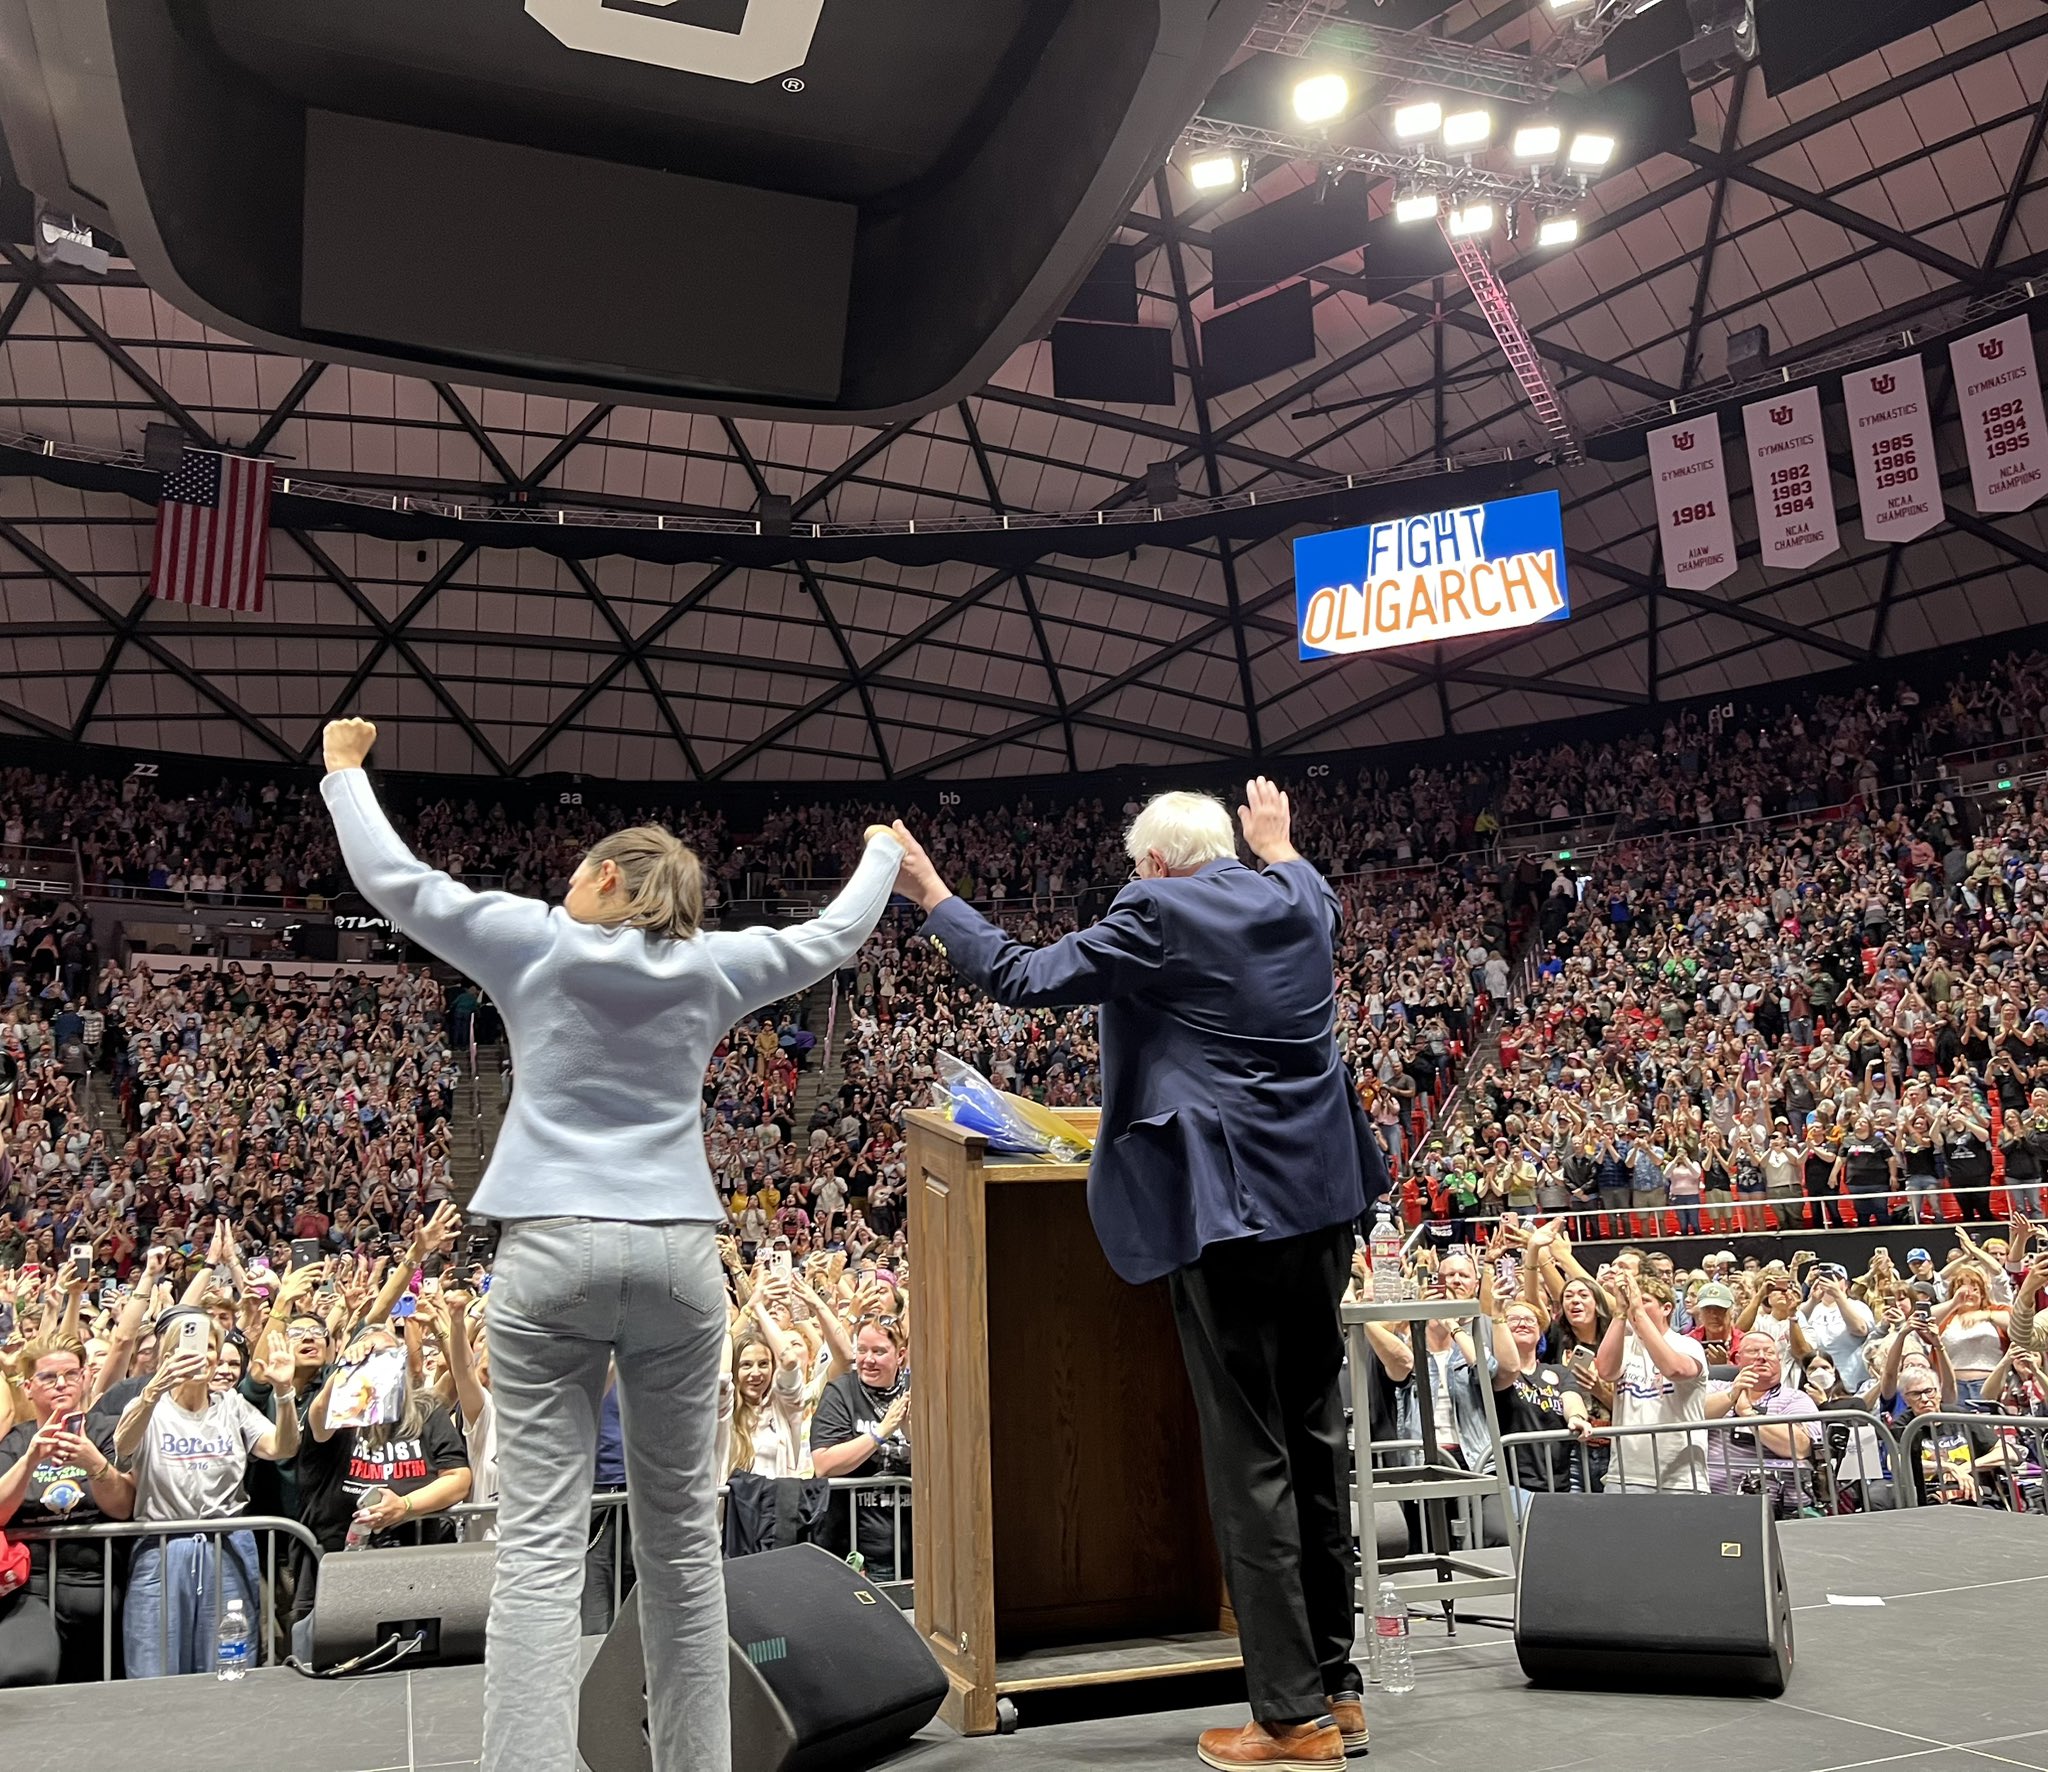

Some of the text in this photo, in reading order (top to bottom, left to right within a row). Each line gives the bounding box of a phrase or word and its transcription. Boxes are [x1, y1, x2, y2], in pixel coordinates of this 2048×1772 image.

[1968, 366, 2027, 396] GYMNASTICS
[1859, 403, 1918, 427] GYMNASTICS
[1981, 398, 2023, 425] 1992
[1984, 415, 2026, 442] 1994
[1758, 434, 1814, 457] GYMNASTICS
[1872, 433, 1913, 456] 1985
[1987, 432, 2029, 459] 1995
[1661, 459, 1714, 482] GYMNASTICS
[1874, 450, 1916, 473] 1986
[1999, 462, 2026, 479] NCAA
[1770, 464, 1810, 485] 1982
[1876, 467, 1918, 489] 1990
[1989, 469, 2041, 495] CHAMPIONS
[1772, 480, 1812, 501] 1983
[1888, 494, 1913, 509] NCAA
[1672, 501, 1716, 526] 1981
[1774, 496, 1814, 517] 1984
[1876, 502, 1929, 524] CHAMPIONS
[1774, 531, 1824, 551] CHAMPIONS
[1785, 523, 1810, 537] NCAA
[1370, 507, 1482, 576] FIGHT
[1689, 546, 1709, 559] AIAW
[1677, 553, 1724, 573] CHAMPIONS
[1304, 551, 1561, 645] OLIGARCHY
[559, 791, 583, 805] aa
[939, 792, 961, 805] bb
[857, 1491, 878, 1507] THE
